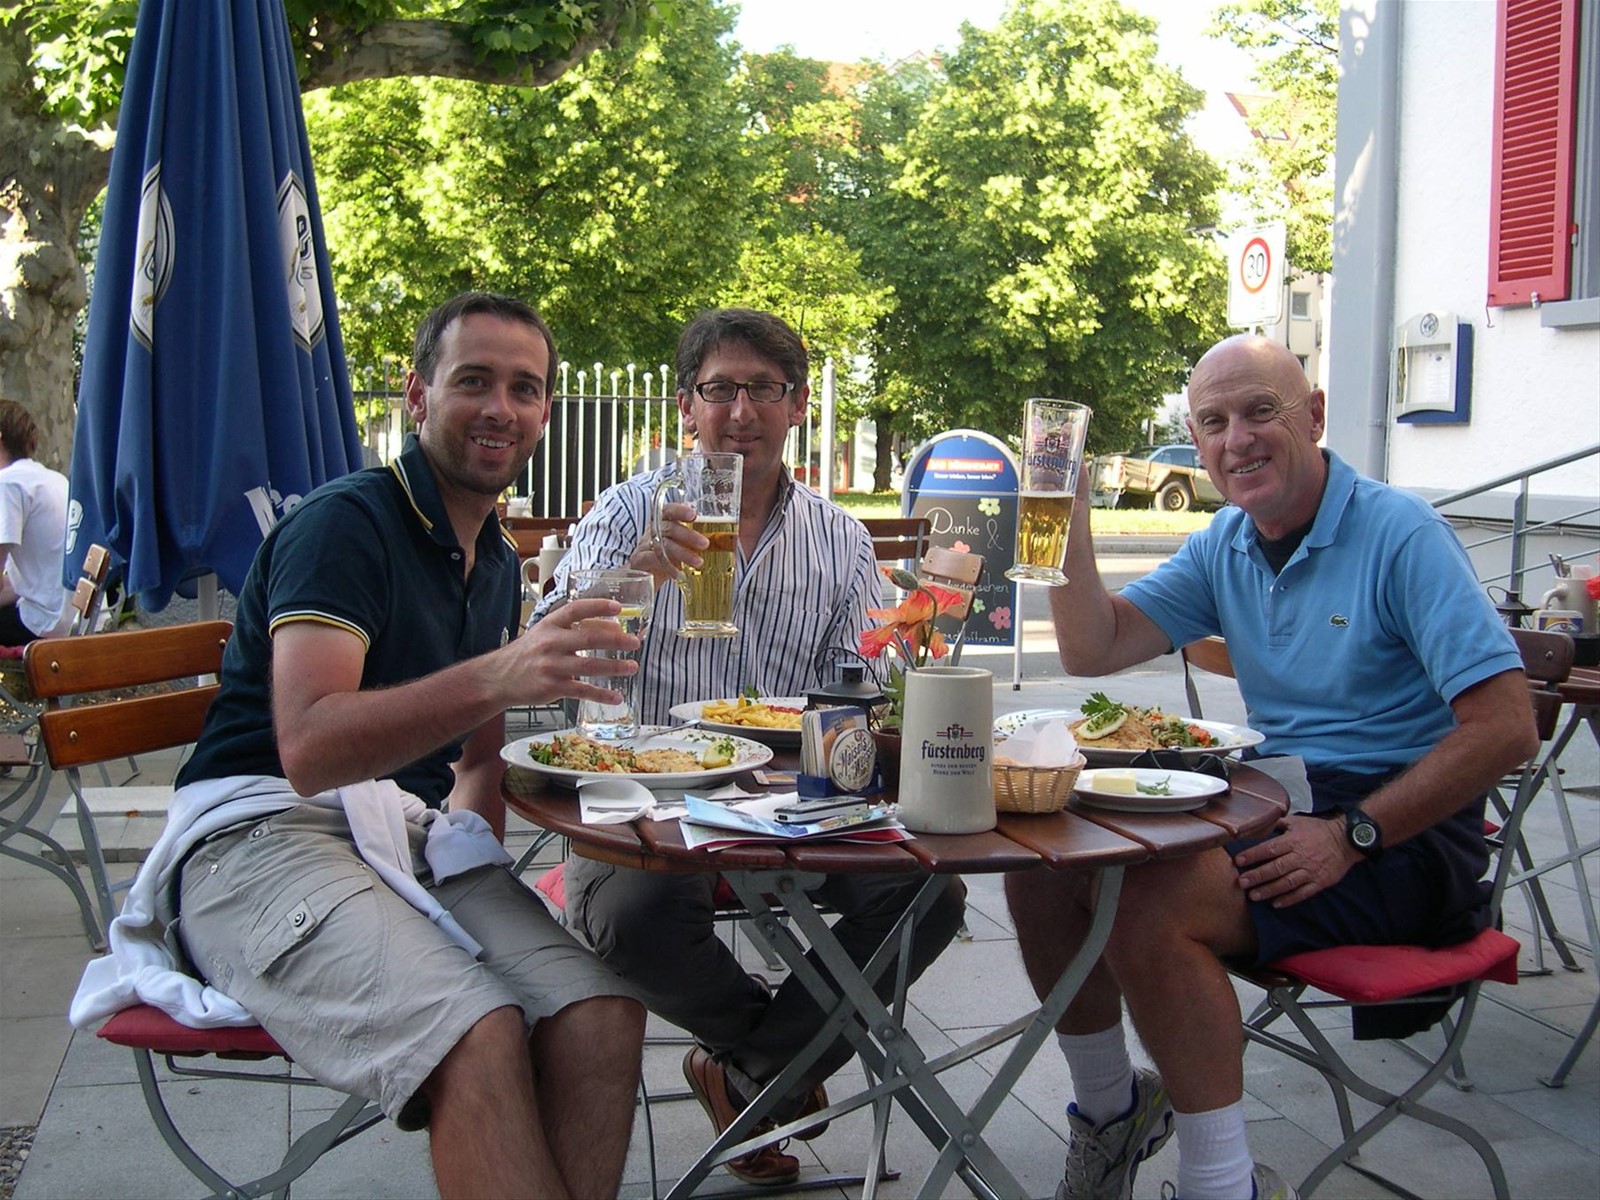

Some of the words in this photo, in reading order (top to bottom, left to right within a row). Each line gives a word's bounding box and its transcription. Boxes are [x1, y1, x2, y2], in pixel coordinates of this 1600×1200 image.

[1247, 252, 1265, 279] 30
[923, 507, 981, 537] Danke
[986, 518, 1004, 551] &
